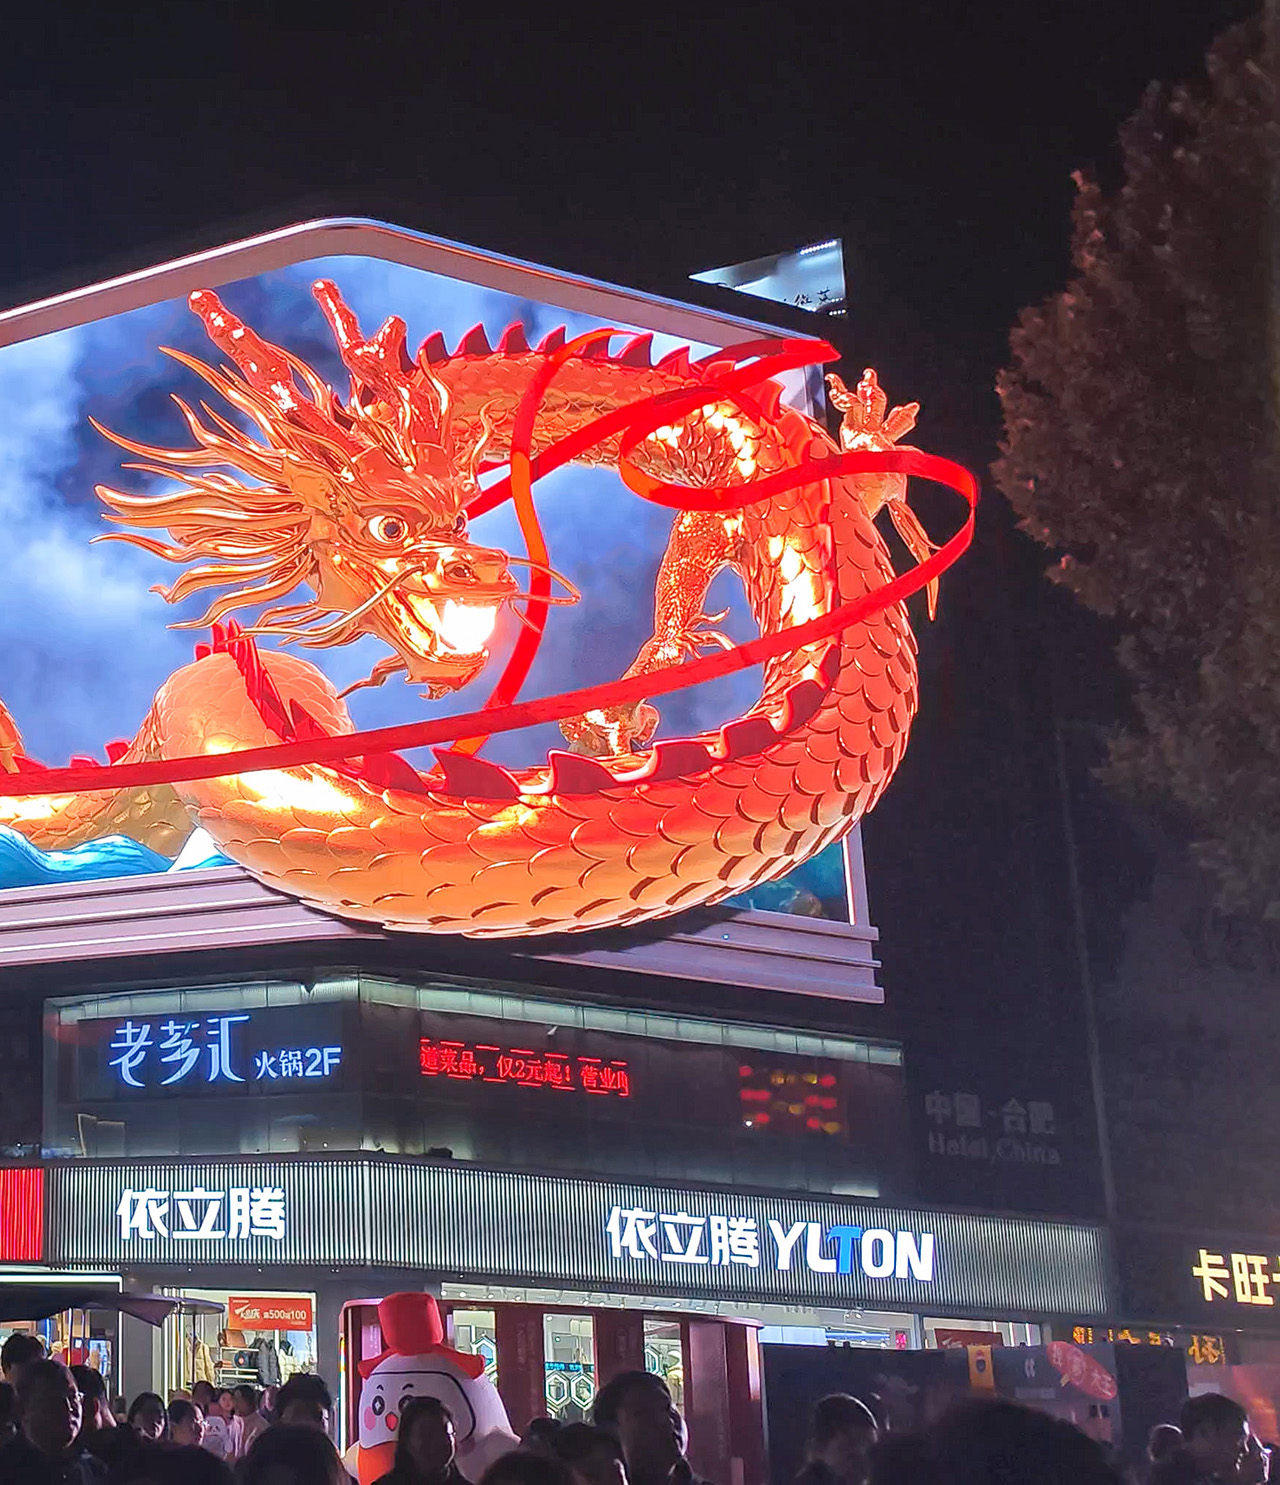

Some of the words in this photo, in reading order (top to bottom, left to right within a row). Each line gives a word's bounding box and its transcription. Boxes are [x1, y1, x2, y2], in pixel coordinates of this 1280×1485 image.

[254, 1046, 342, 1080] 火锅2F
[116, 1186, 287, 1241] 依立腾
[605, 1205, 760, 1270] 依立腾
[768, 1218, 935, 1283] YLTON
[1192, 1248, 1280, 1306] 卡旺
